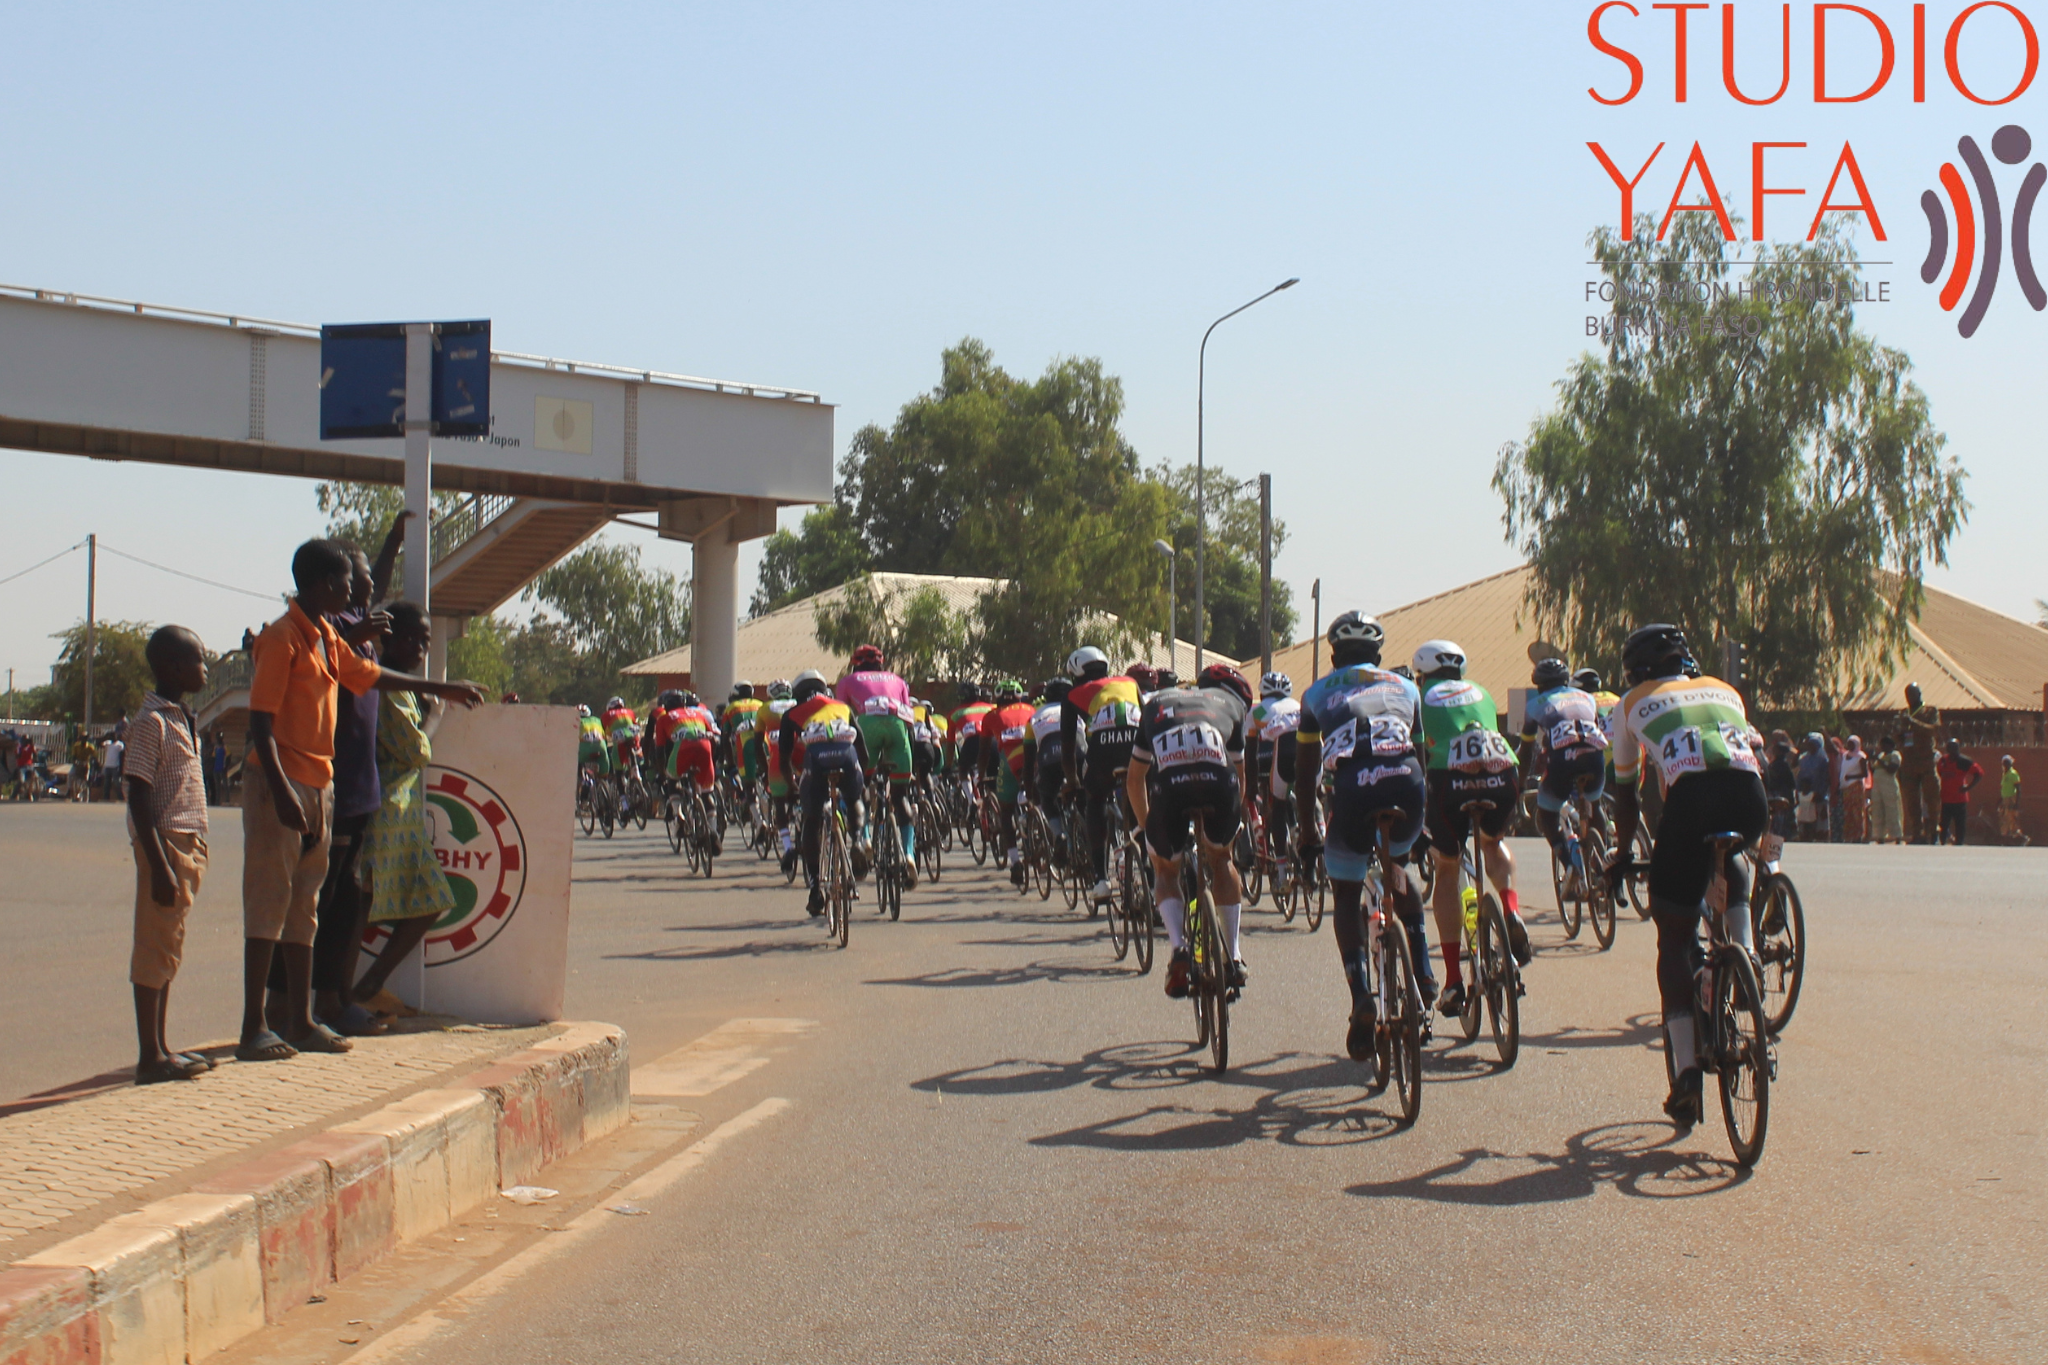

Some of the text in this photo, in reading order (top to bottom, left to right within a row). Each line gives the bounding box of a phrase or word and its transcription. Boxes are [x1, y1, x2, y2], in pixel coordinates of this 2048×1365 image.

[489, 432, 520, 448] Japon
[1638, 697, 1679, 719] COTE
[1371, 720, 1407, 743] 23
[1451, 735, 1483, 760] 16
[1663, 731, 1697, 761] 41
[1170, 771, 1219, 785] HAROL
[1452, 775, 1507, 790] HAROL
[437, 848, 493, 871] BHY
